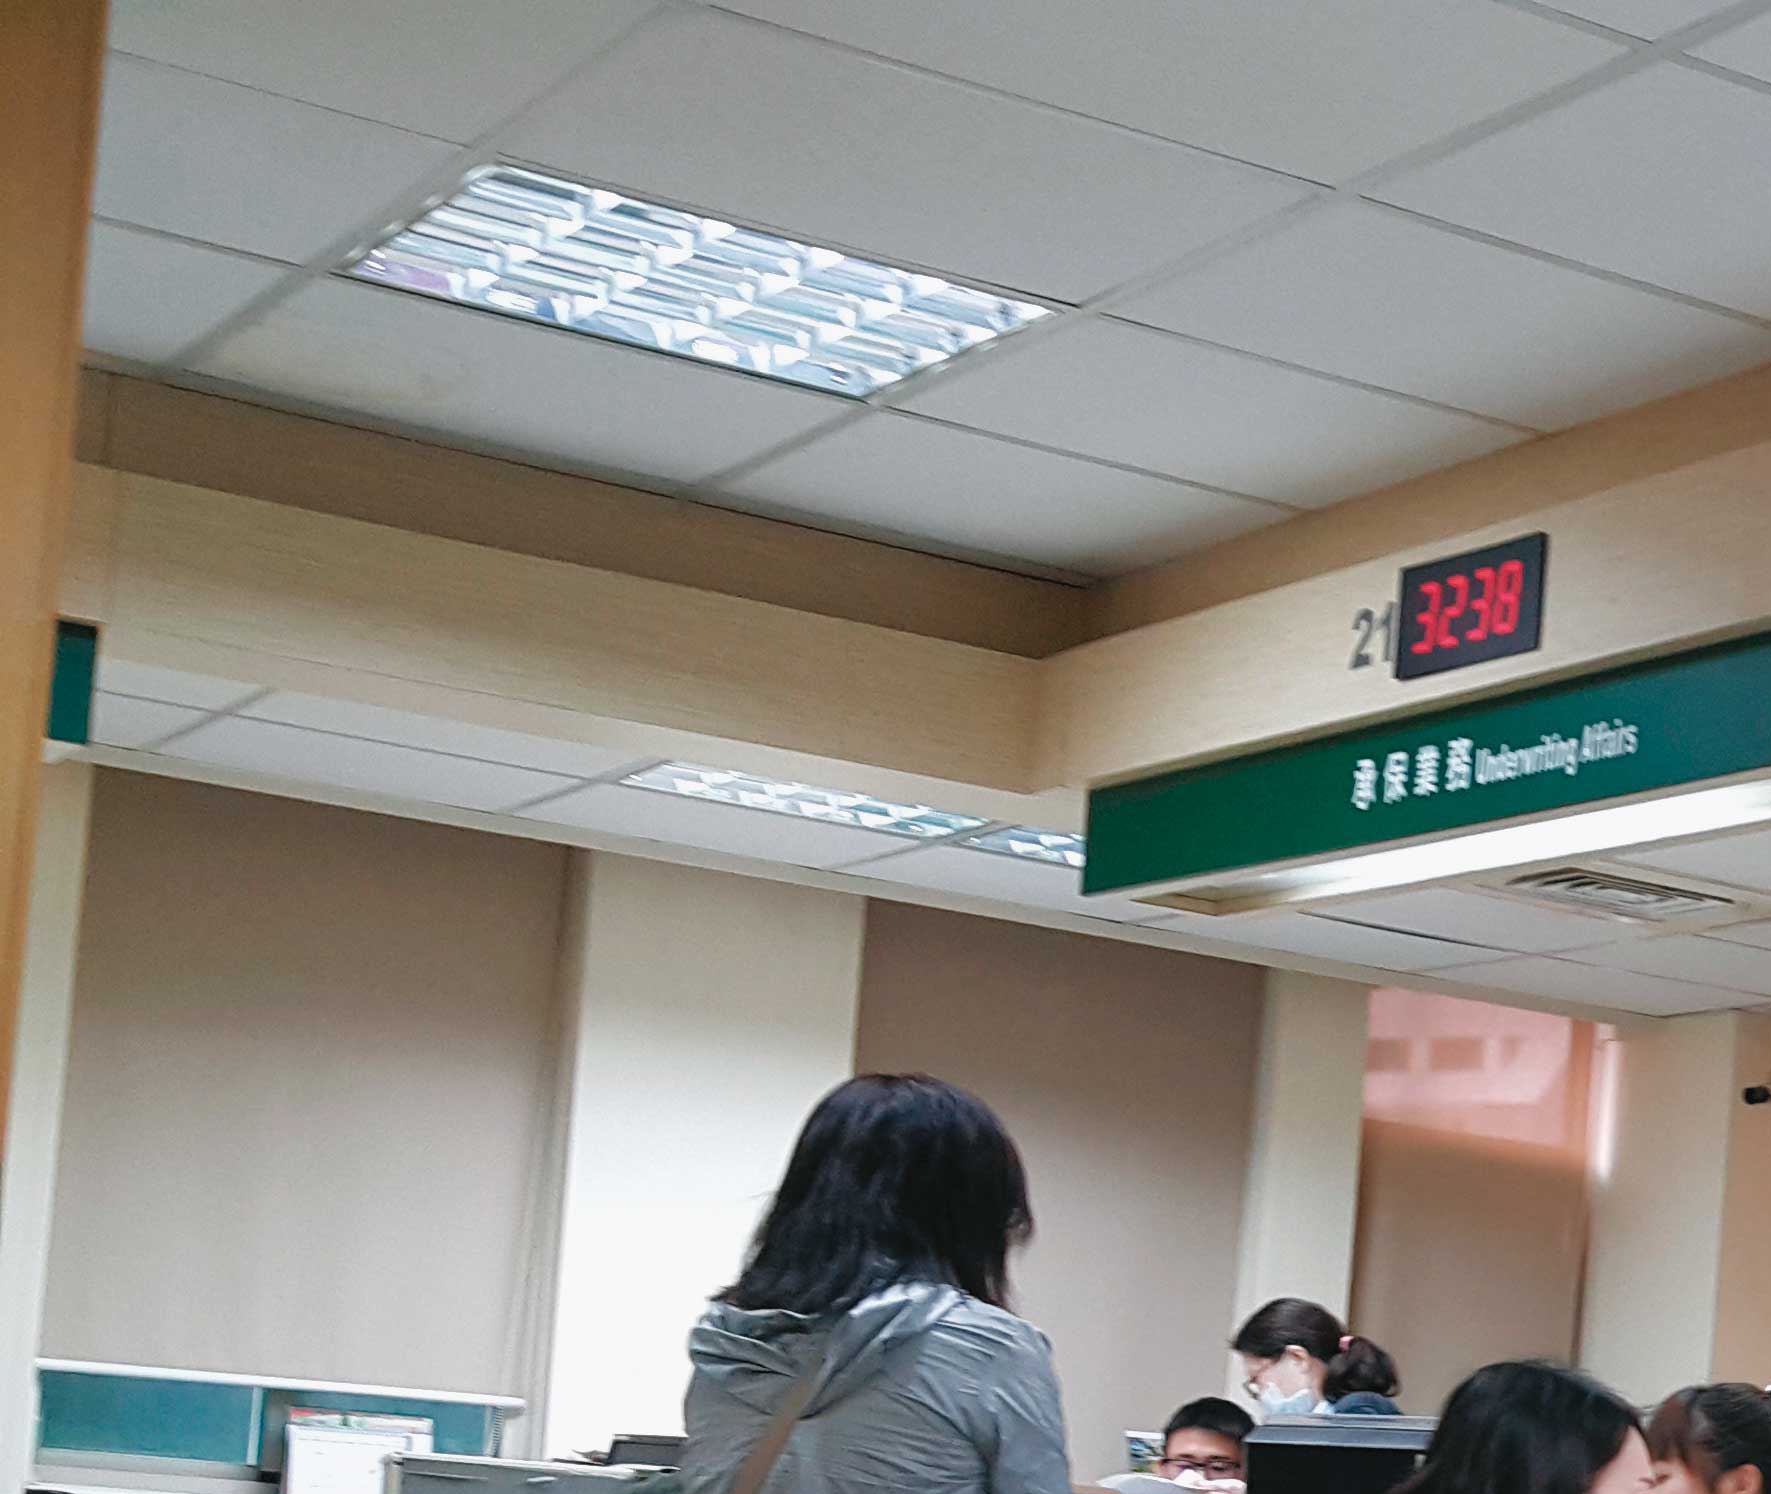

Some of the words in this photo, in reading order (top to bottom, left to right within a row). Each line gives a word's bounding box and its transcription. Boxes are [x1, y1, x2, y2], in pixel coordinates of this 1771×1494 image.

[1350, 600, 1398, 671] 21
[1411, 559, 1524, 655] 3238
[1351, 736, 1474, 811] 承保業務
[1475, 732, 1579, 785] Underwriting
[1578, 717, 1639, 764] Affairs
